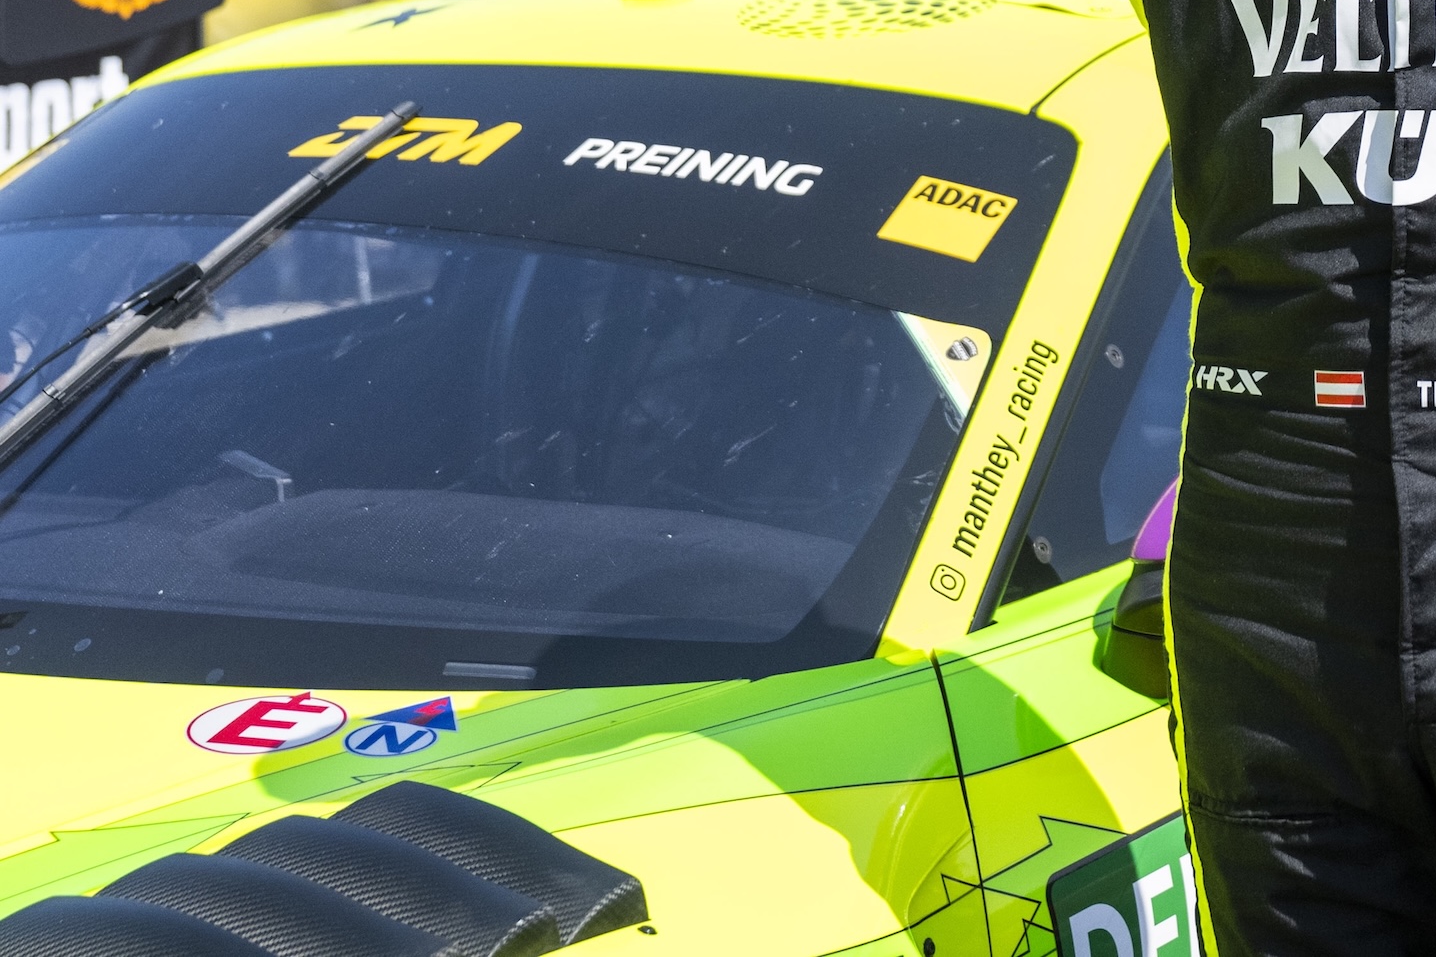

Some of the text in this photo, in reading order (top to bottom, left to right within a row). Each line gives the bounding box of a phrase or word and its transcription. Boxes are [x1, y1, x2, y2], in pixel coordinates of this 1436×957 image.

[288, 115, 523, 166] DTM
[563, 138, 824, 197] PREINING
[913, 182, 1007, 218] ADAC
[1195, 366, 1268, 397] HRX
[951, 339, 1060, 559] manthey_racing
